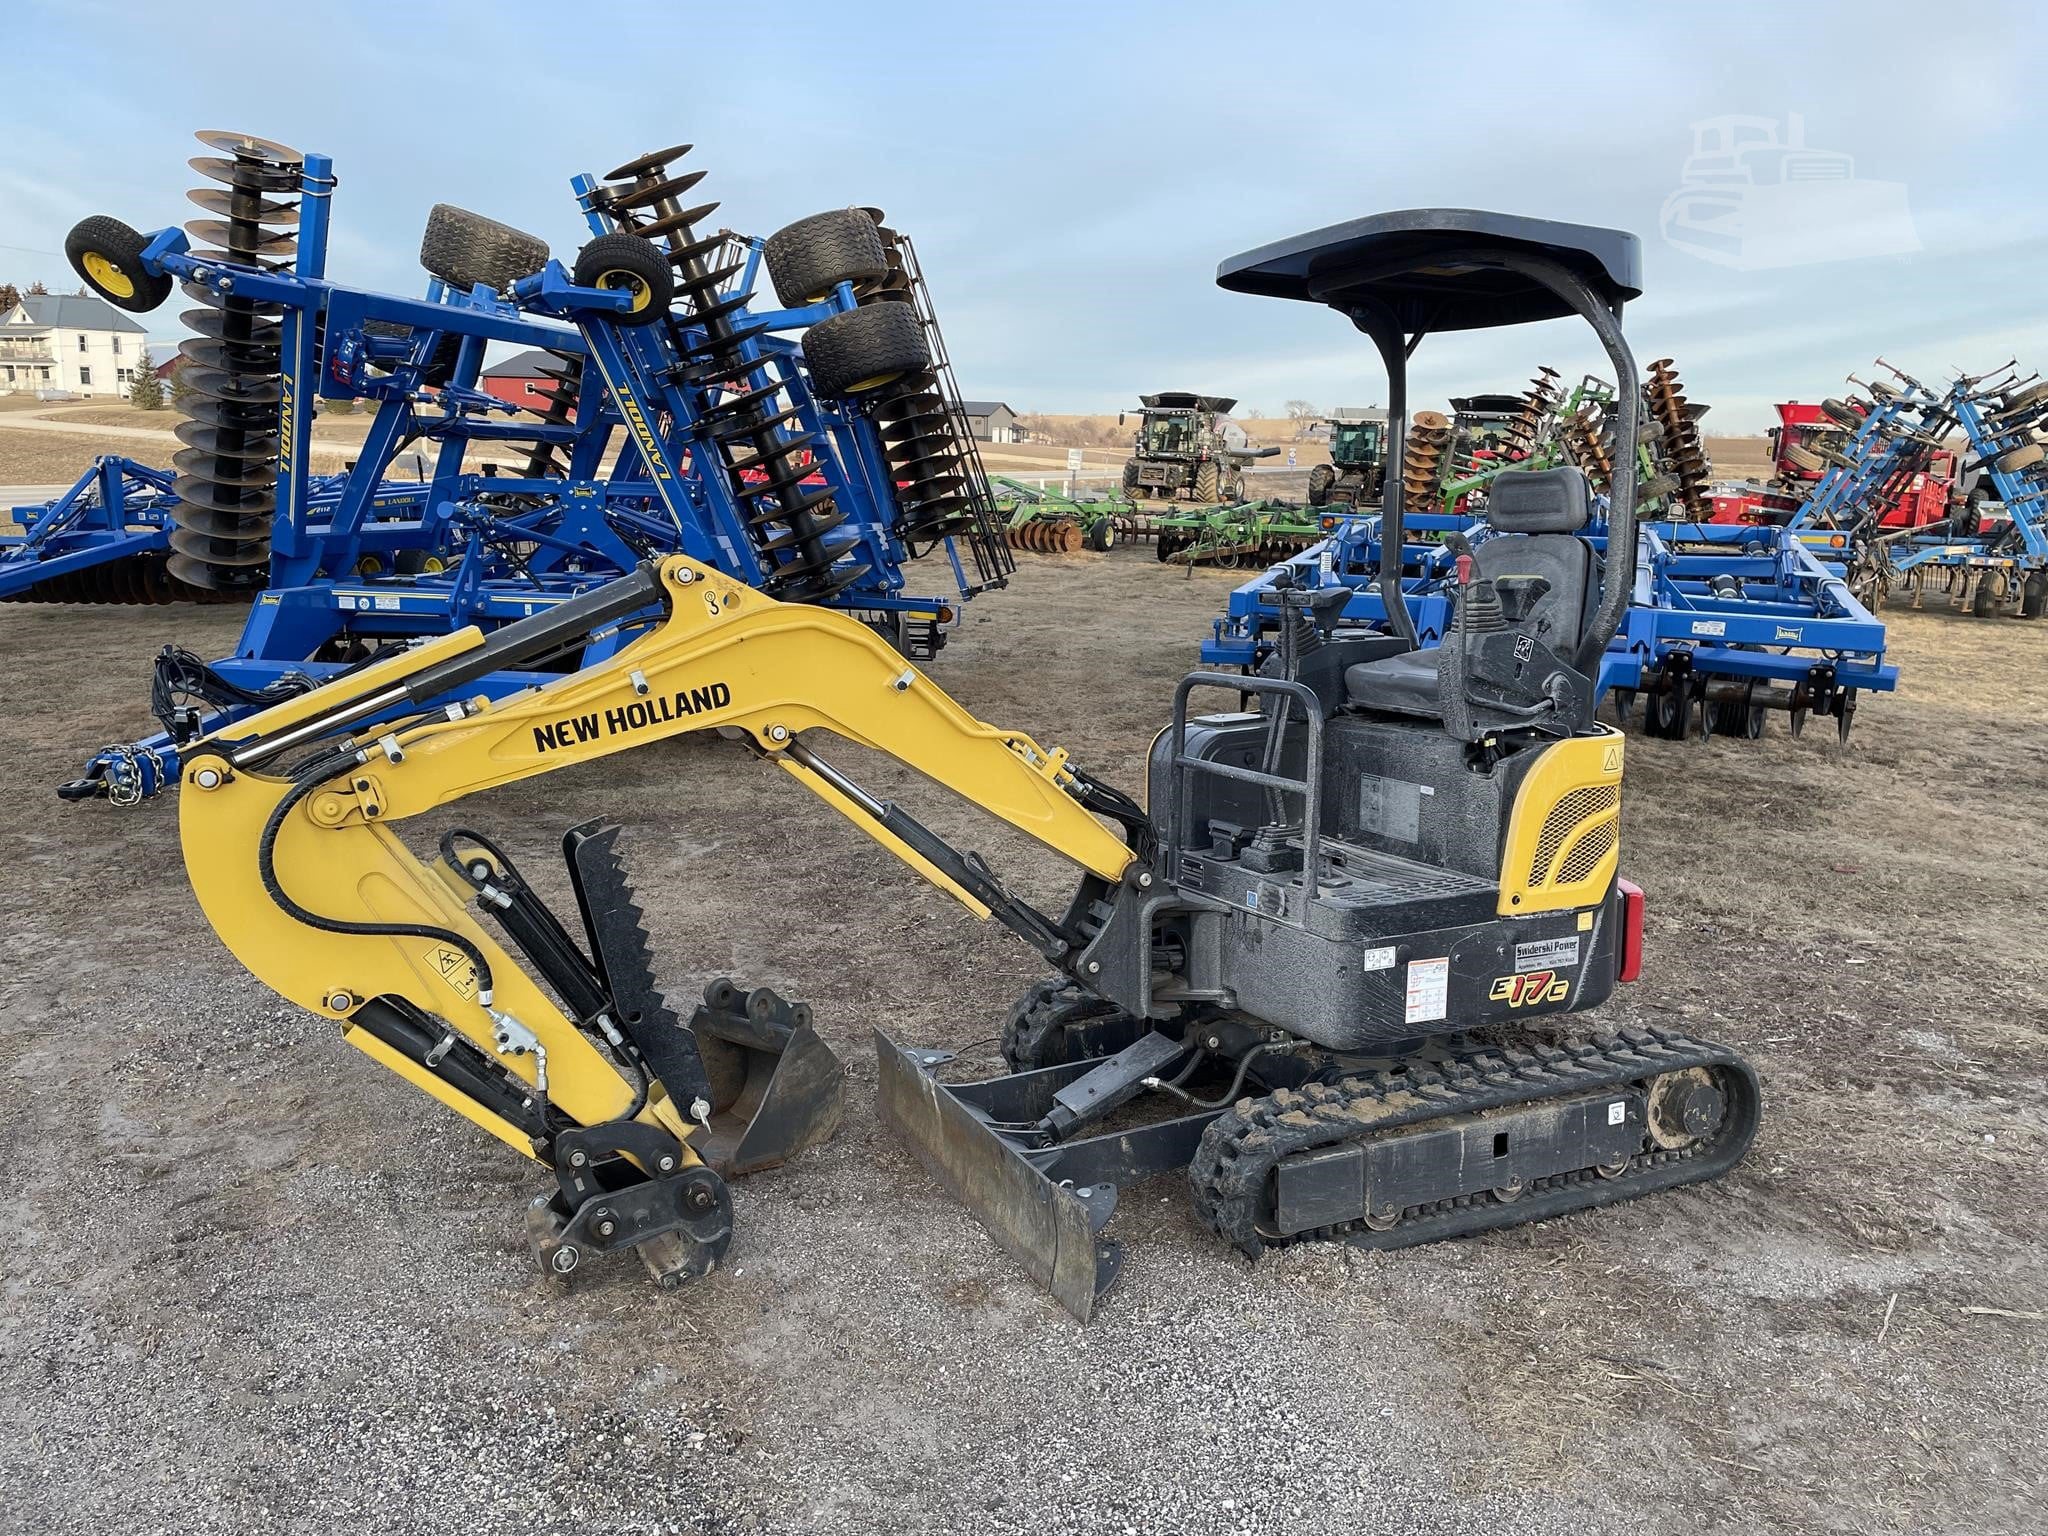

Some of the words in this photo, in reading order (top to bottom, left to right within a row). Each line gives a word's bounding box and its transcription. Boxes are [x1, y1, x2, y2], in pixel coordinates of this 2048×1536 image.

[280, 373, 293, 473] LANDOLL
[618, 382, 671, 479] LANDOLL
[533, 713, 600, 752] NEW
[605, 682, 731, 735] HOLLAND
[1517, 943, 1553, 956] Swiderski
[1554, 941, 1577, 951] Power
